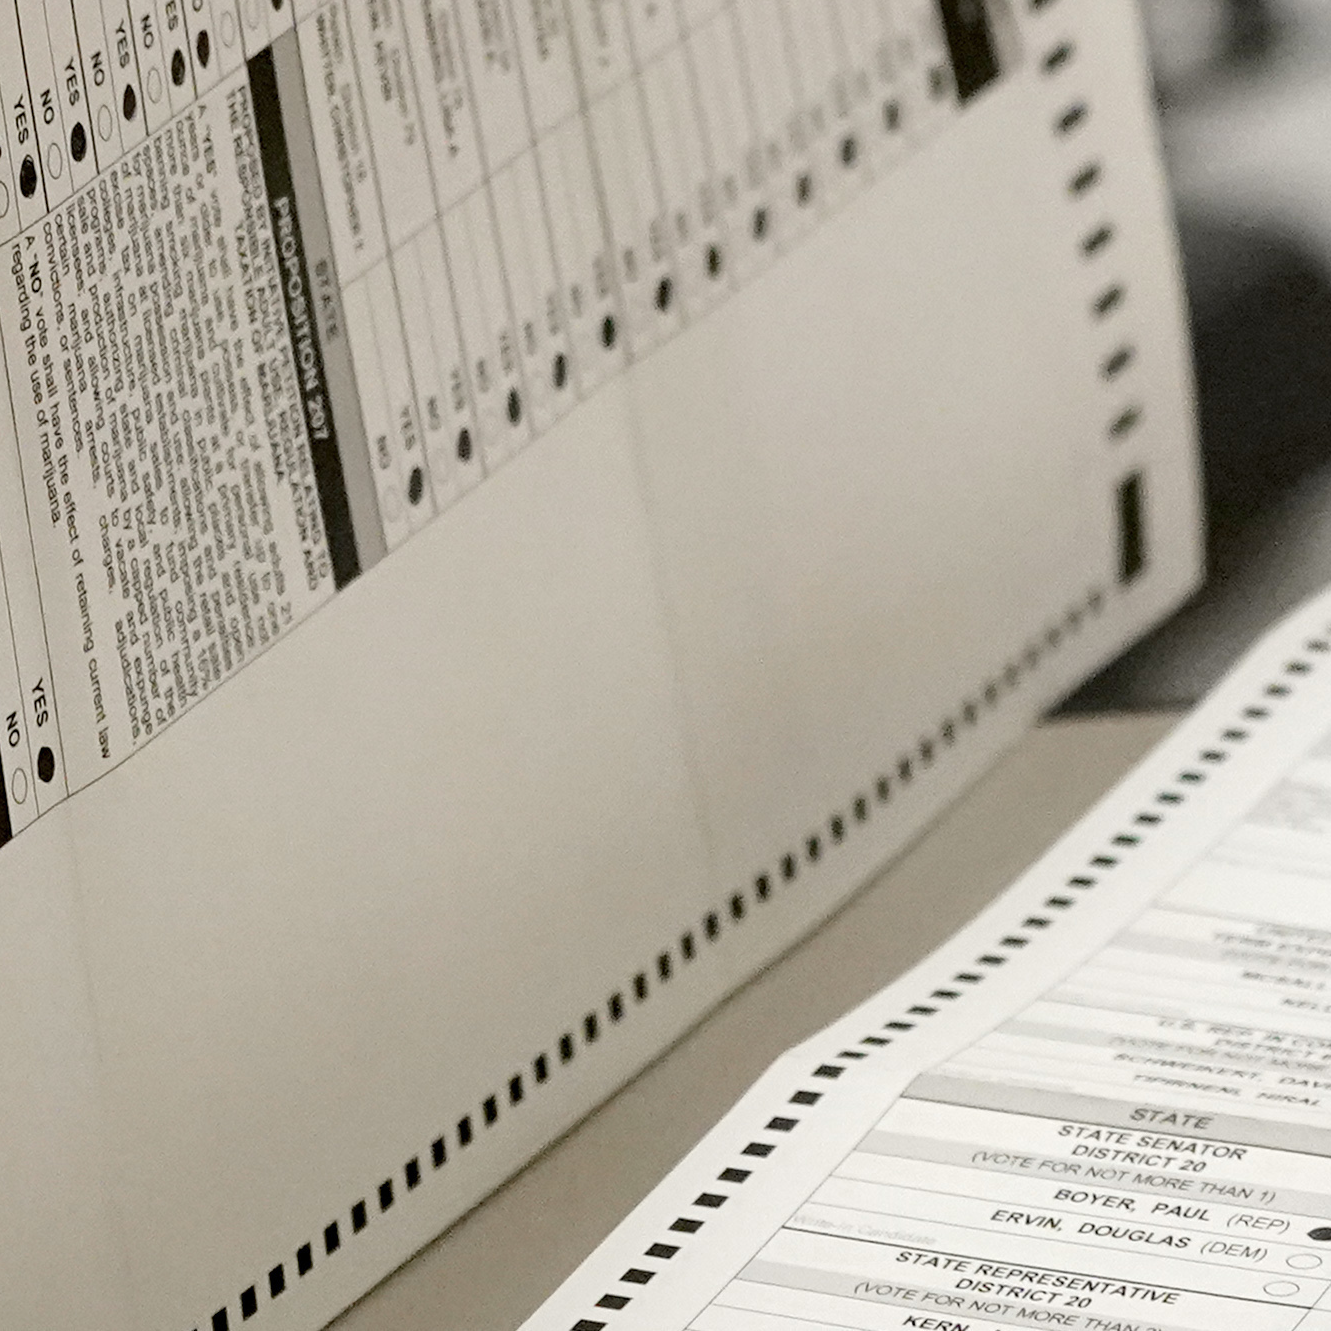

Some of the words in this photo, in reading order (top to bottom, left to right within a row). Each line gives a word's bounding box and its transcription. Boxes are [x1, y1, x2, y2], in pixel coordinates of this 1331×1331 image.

[13, 94, 30, 146] YES
[24, 235, 36, 251] A
[11, 242, 32, 333] regarding
[35, 305, 49, 349] vote
[273, 196, 320, 392] PROPOSITION
[306, 394, 329, 440] 207
[24, 334, 37, 367] the
[29, 370, 43, 406] use
[42, 353, 59, 399] shall
[36, 409, 50, 428] of
[49, 401, 64, 450] have
[38, 431, 62, 529] marijuana.
[57, 453, 69, 486] the
[63, 490, 80, 545] effect
[71, 548, 85, 567] of
[75, 572, 95, 654] retaining
[31, 676, 49, 728] YES
[88, 657, 107, 725] current
[5, 710, 21, 748] NO
[98, 726, 111, 759] law
[1129, 1107, 1214, 1130] STATE
[1057, 1124, 1133, 1145] STATE
[1136, 1135, 1248, 1161] SENATOR
[1071, 1144, 1178, 1169] DISTRICT
[1178, 1159, 1207, 1173] 20
[971, 1150, 1037, 1169] (VOTE
[1037, 1159, 1083, 1176] FOR
[1084, 1165, 1131, 1182] NOT
[1131, 1172, 1195, 1191] MORE
[1200, 1181, 1255, 1200] THAN
[1259, 1190, 1277, 1206] 1)
[1052, 1188, 1136, 1213] BOYER,
[1150, 1202, 1209, 1222] PAUL
[1226, 1213, 1291, 1235] (REP)
[989, 1209, 1063, 1232] ERVIN,
[1077, 1222, 1192, 1249] DOUGLAS
[1199, 1241, 1268, 1263] (DEM)
[895, 1251, 971, 1273] STATE
[974, 1263, 1180, 1305] REPRESENTATIVE
[954, 1278, 1063, 1304] DISTRICT
[1063, 1295, 1093, 1309] 20
